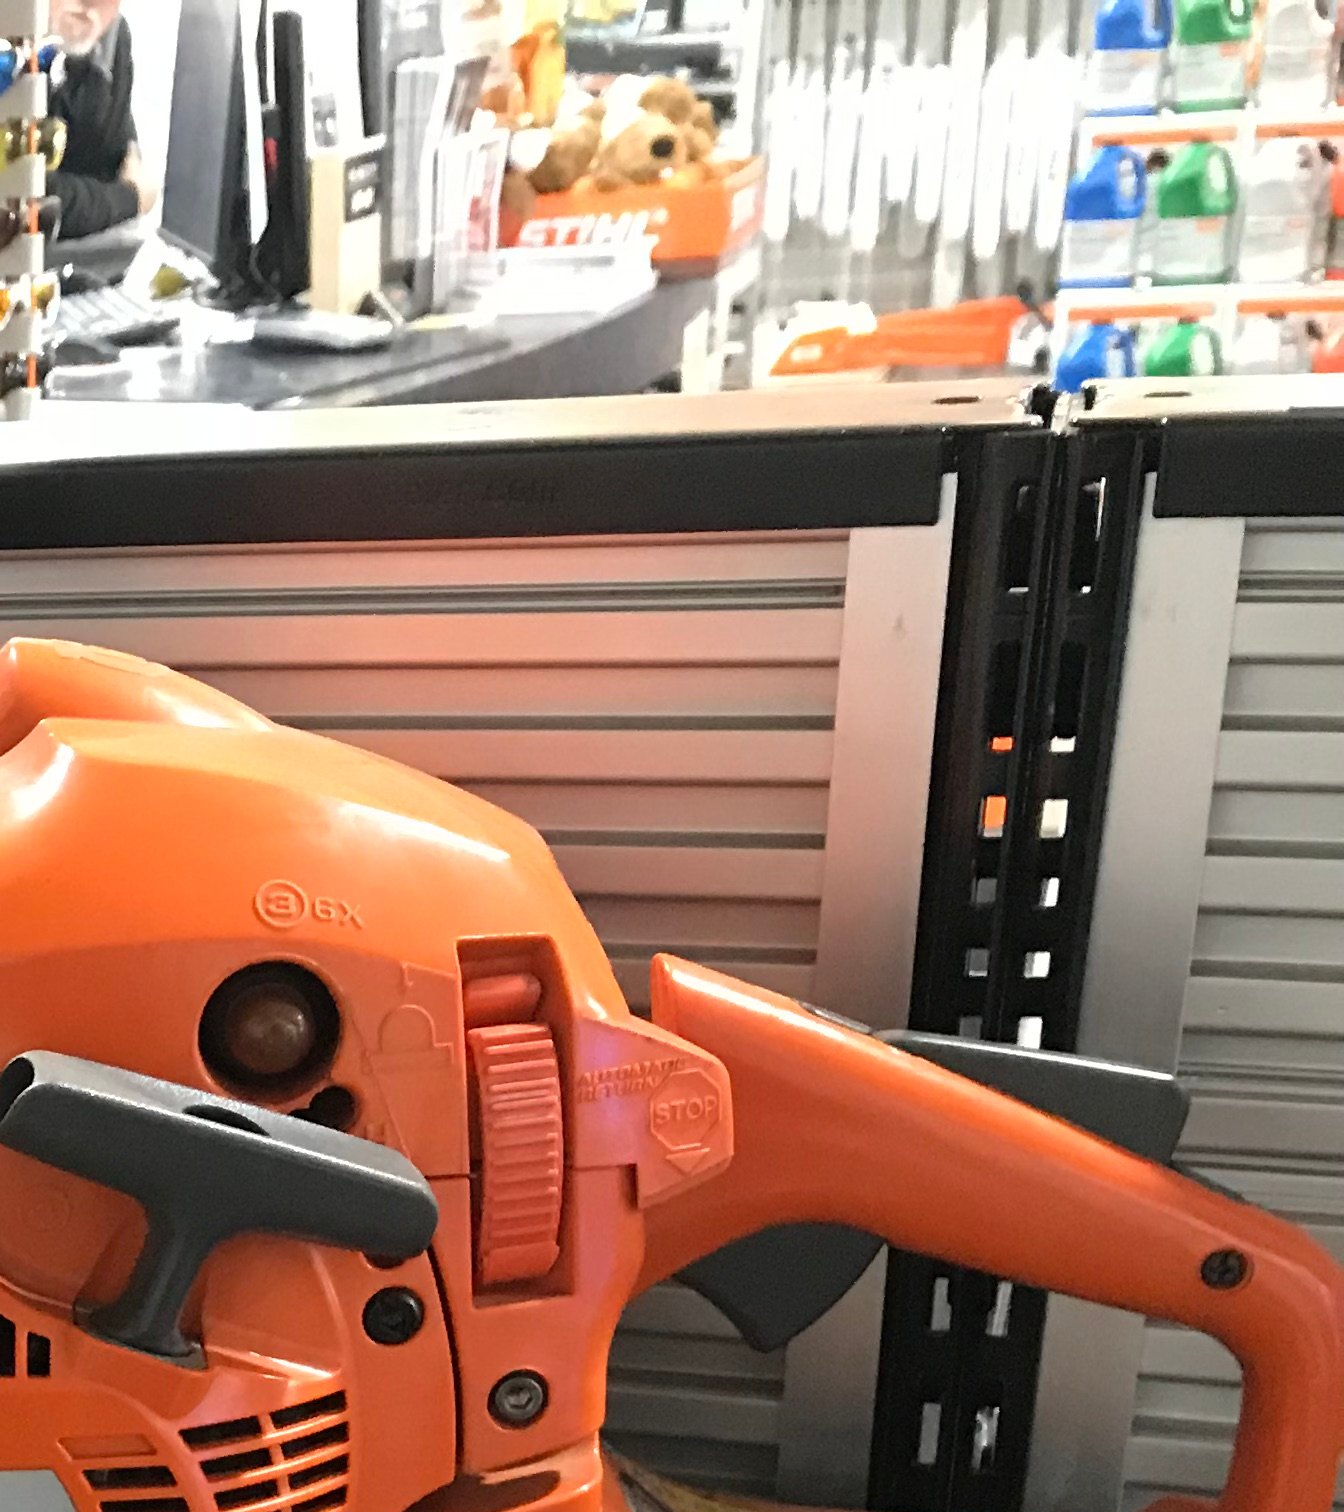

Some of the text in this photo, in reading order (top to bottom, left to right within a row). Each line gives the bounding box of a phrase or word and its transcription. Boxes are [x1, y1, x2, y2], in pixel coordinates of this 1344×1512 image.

[518, 211, 659, 248] STIHL
[312, 895, 364, 930] 6X
[654, 1094, 718, 1125] STOP
